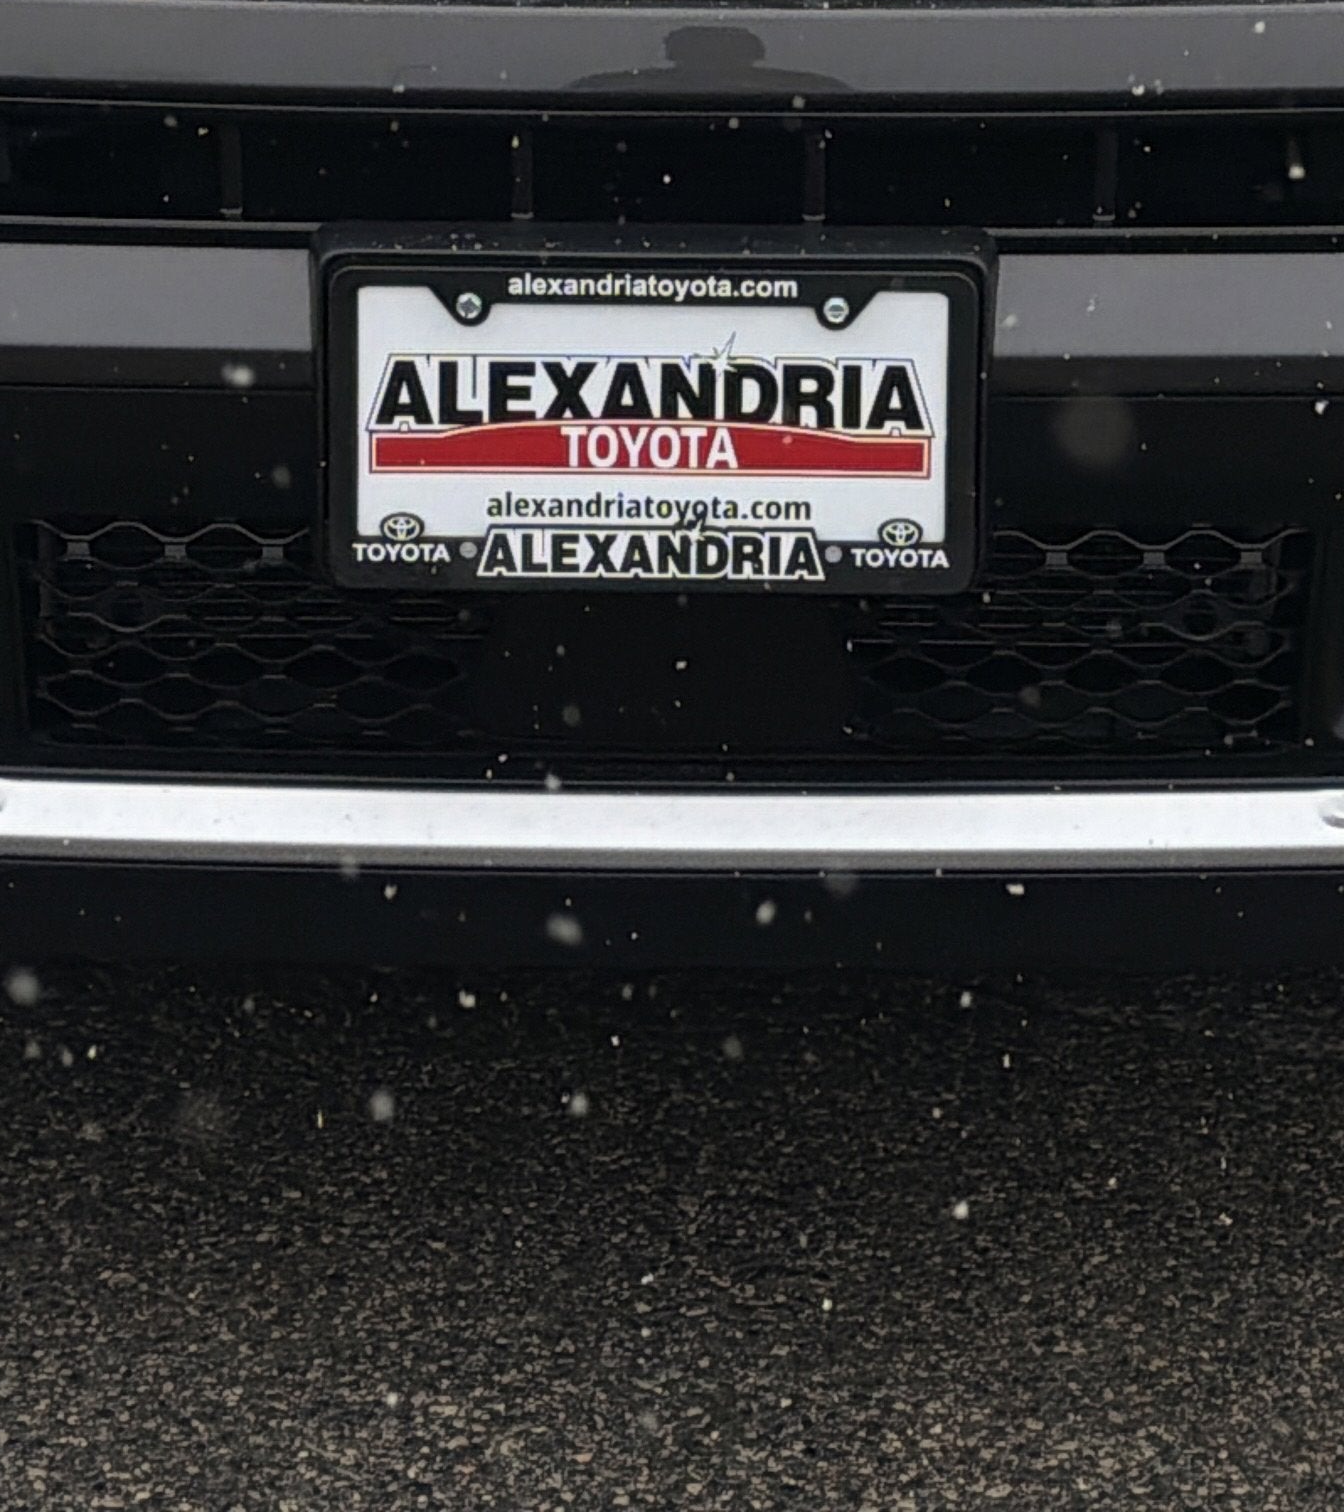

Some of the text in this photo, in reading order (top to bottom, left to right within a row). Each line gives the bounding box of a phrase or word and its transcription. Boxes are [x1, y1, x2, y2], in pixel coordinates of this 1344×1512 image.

[508, 273, 798, 301] alexandriatoyota.com
[372, 357, 928, 431] ALEXANDRIA
[561, 425, 739, 469] TOYOTA
[487, 491, 811, 521] alexandriatoyota.com
[353, 543, 450, 563] TOYOTA
[478, 528, 826, 580] ALEXANDRIA
[852, 547, 949, 569] TOYOTA
